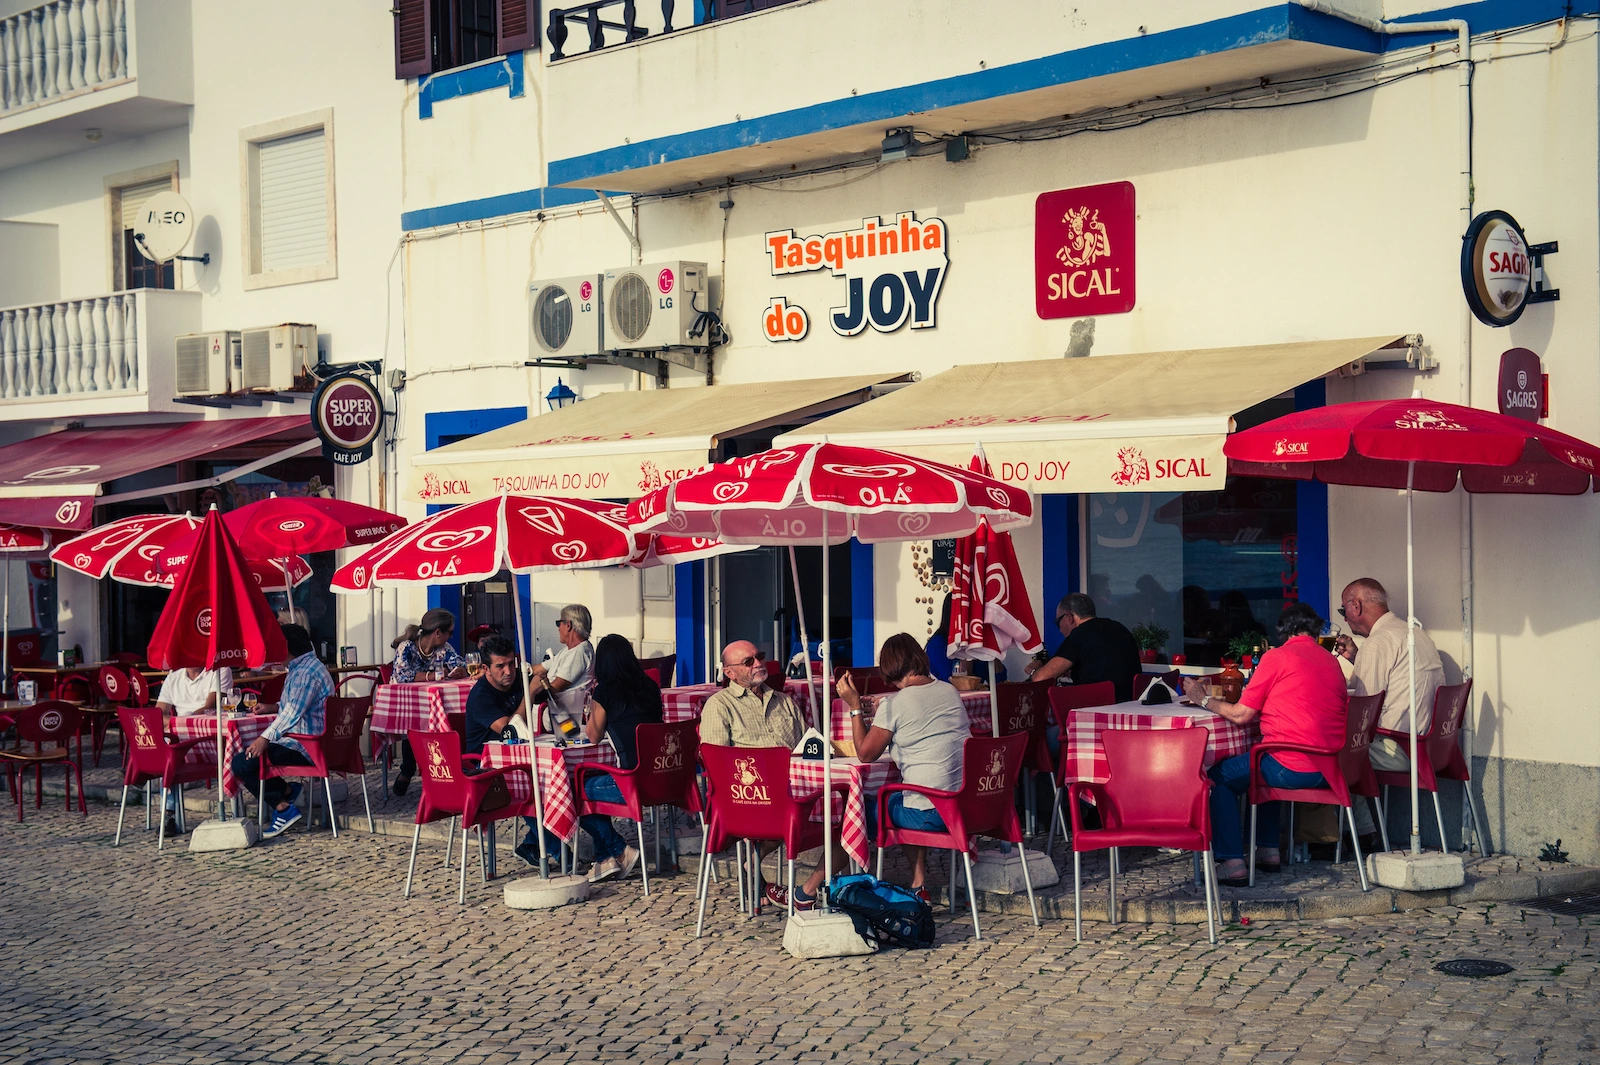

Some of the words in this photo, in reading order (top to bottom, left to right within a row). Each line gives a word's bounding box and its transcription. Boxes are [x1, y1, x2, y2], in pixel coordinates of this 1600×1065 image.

[769, 218, 941, 269] Tasquinha
[1047, 267, 1121, 301] SICAL
[659, 296, 673, 310] LG
[833, 267, 941, 331] JOY
[581, 302, 591, 313] LG
[766, 303, 804, 337] do
[329, 399, 372, 414] SUPER
[1506, 389, 1538, 410] SAGRES
[333, 412, 371, 427] BOCK
[333, 451, 349, 463] CAFÉ
[350, 451, 363, 462] JOY
[1001, 462, 1029, 482] DO
[1034, 460, 1071, 481] JOY
[1155, 458, 1211, 478] SICAL
[443, 479, 471, 495] SICAL
[492, 473, 559, 493] TASQUINHA
[561, 473, 581, 490] DO
[585, 472, 610, 489] JOY
[355, 527, 373, 538] SUPER
[372, 526, 388, 536] BOCK
[167, 555, 188, 567] SUPE
[1008, 714, 1036, 730] SICAL
[134, 734, 157, 747] SICAL
[806, 743, 819, 755] 28
[653, 753, 683, 770] SICAL
[428, 764, 454, 779] SICAL
[977, 773, 1005, 792] SICAL
[730, 784, 771, 801] SICAL
